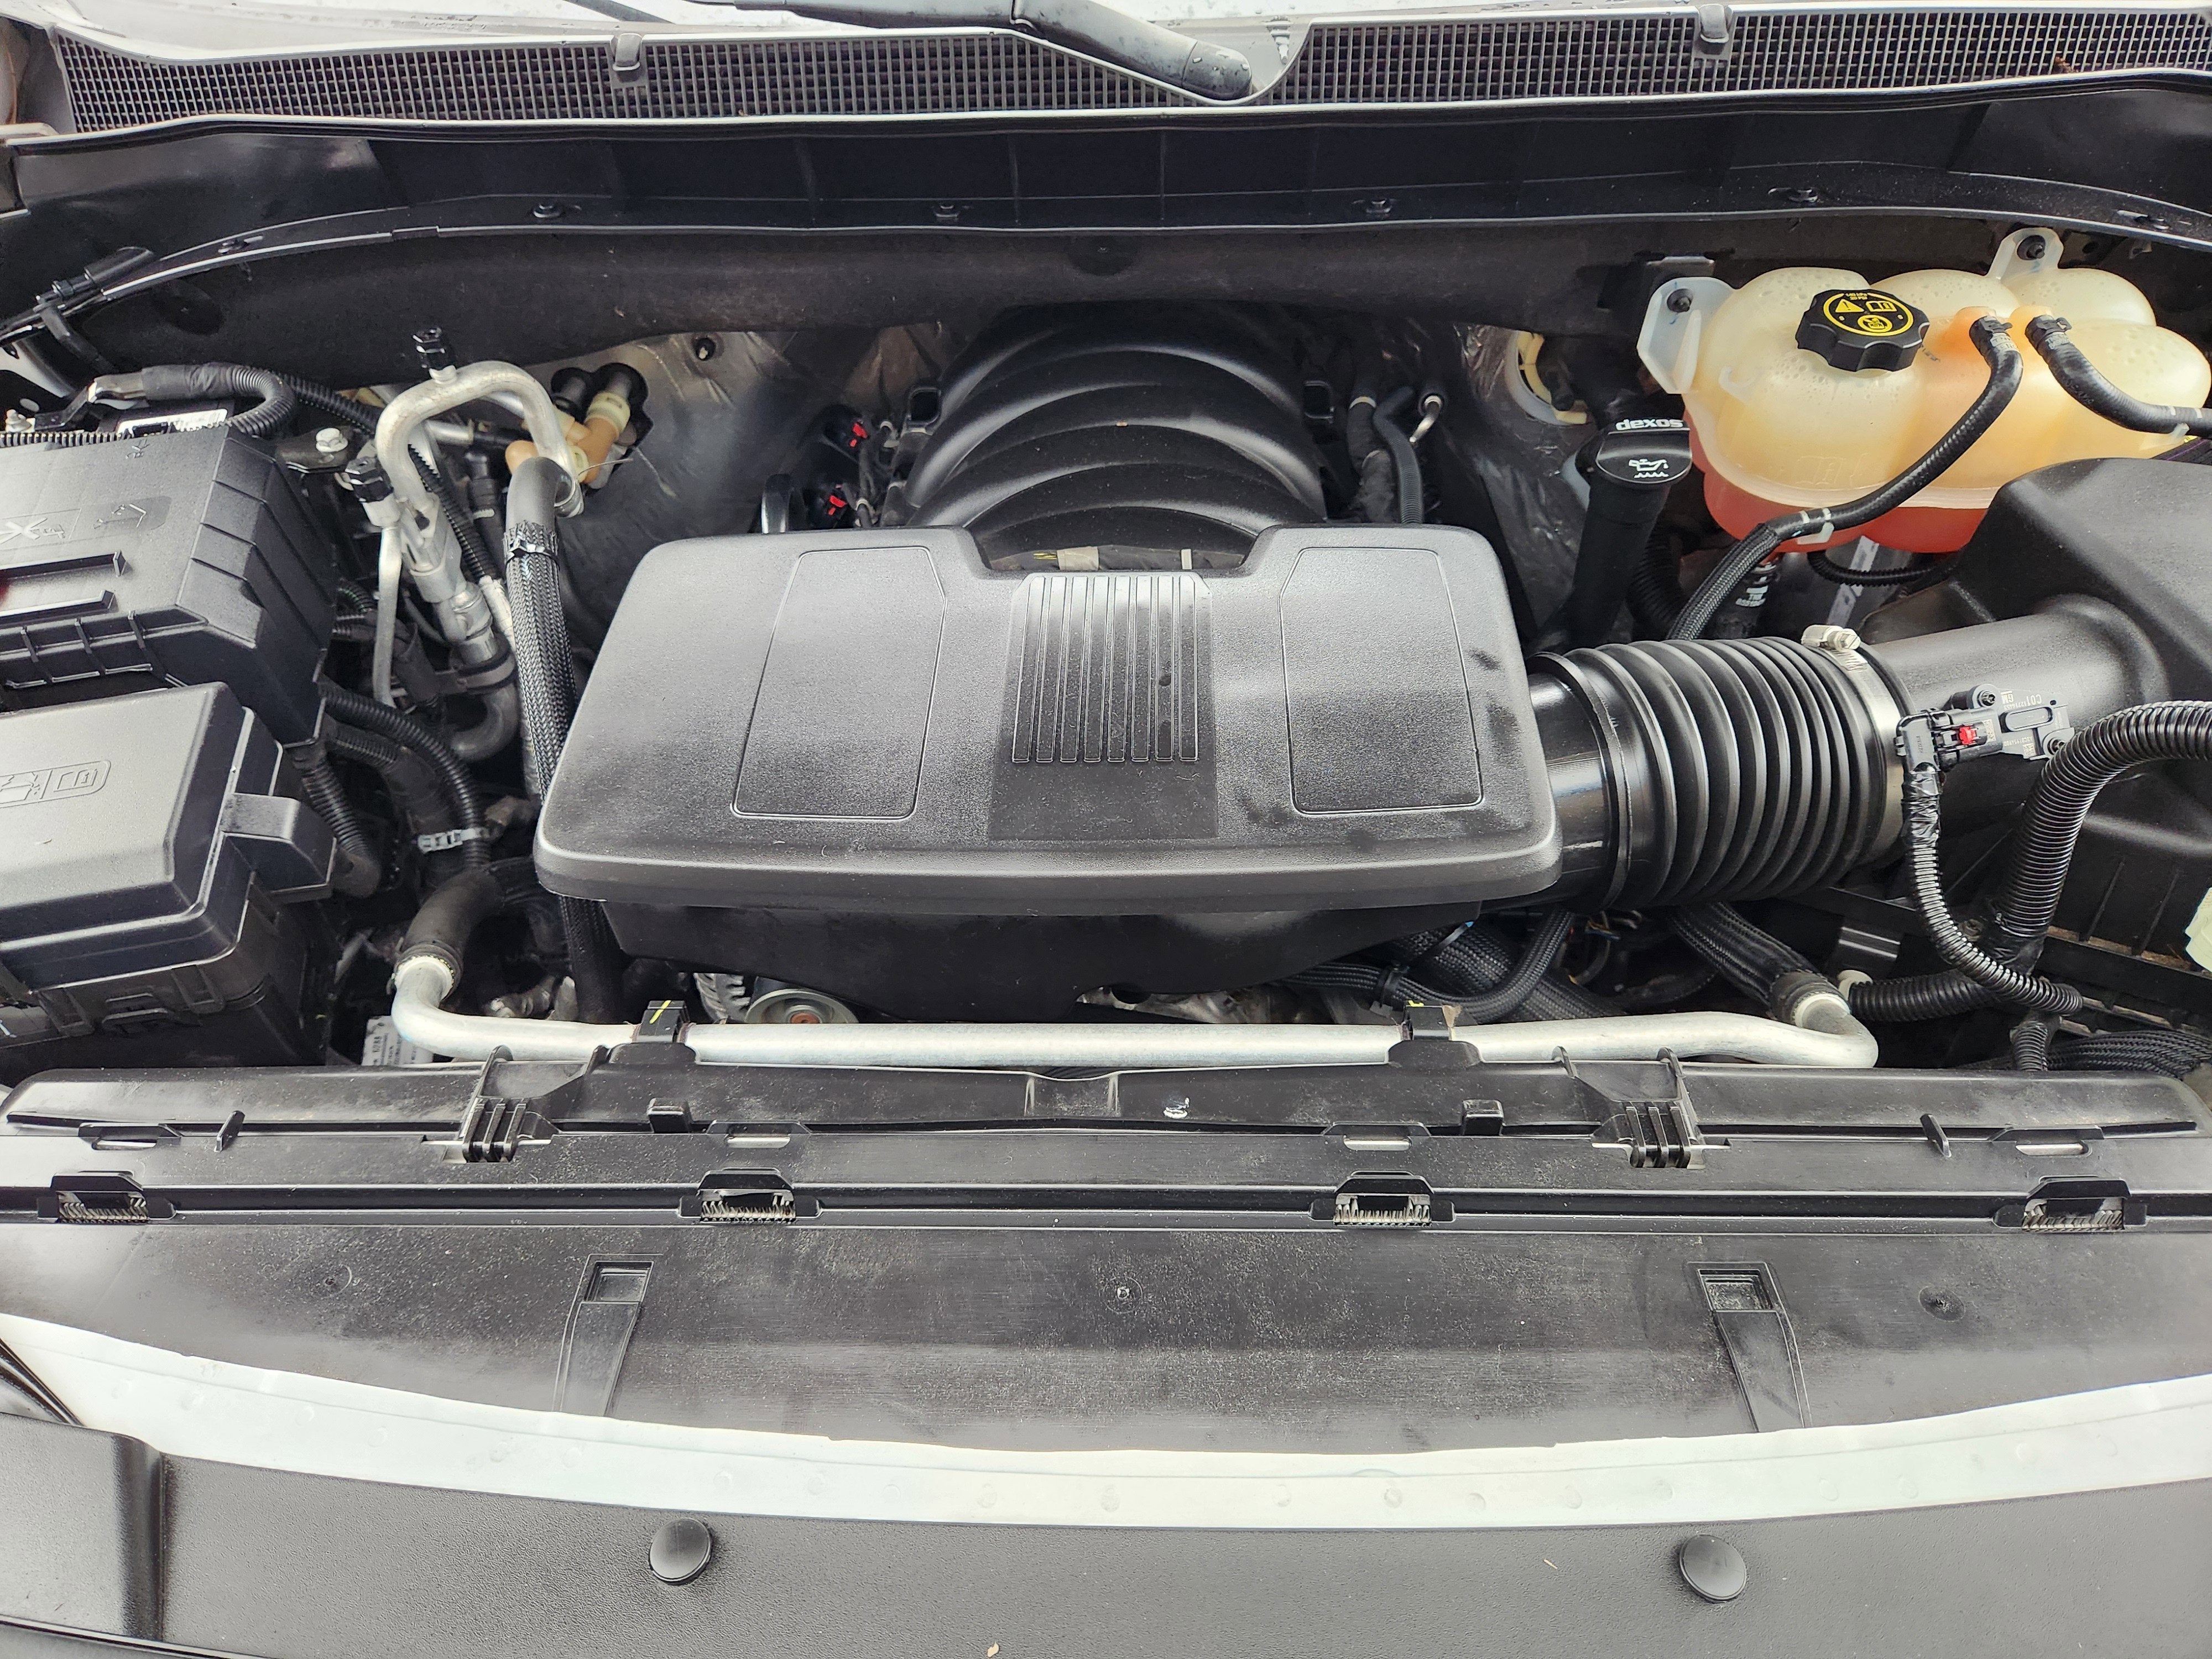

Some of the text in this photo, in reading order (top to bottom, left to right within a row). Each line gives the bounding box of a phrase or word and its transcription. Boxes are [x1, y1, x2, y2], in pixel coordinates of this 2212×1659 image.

[1615, 419, 1683, 430] dexos
[2001, 693, 2014, 705] GM
[2026, 694, 2042, 706] C01
